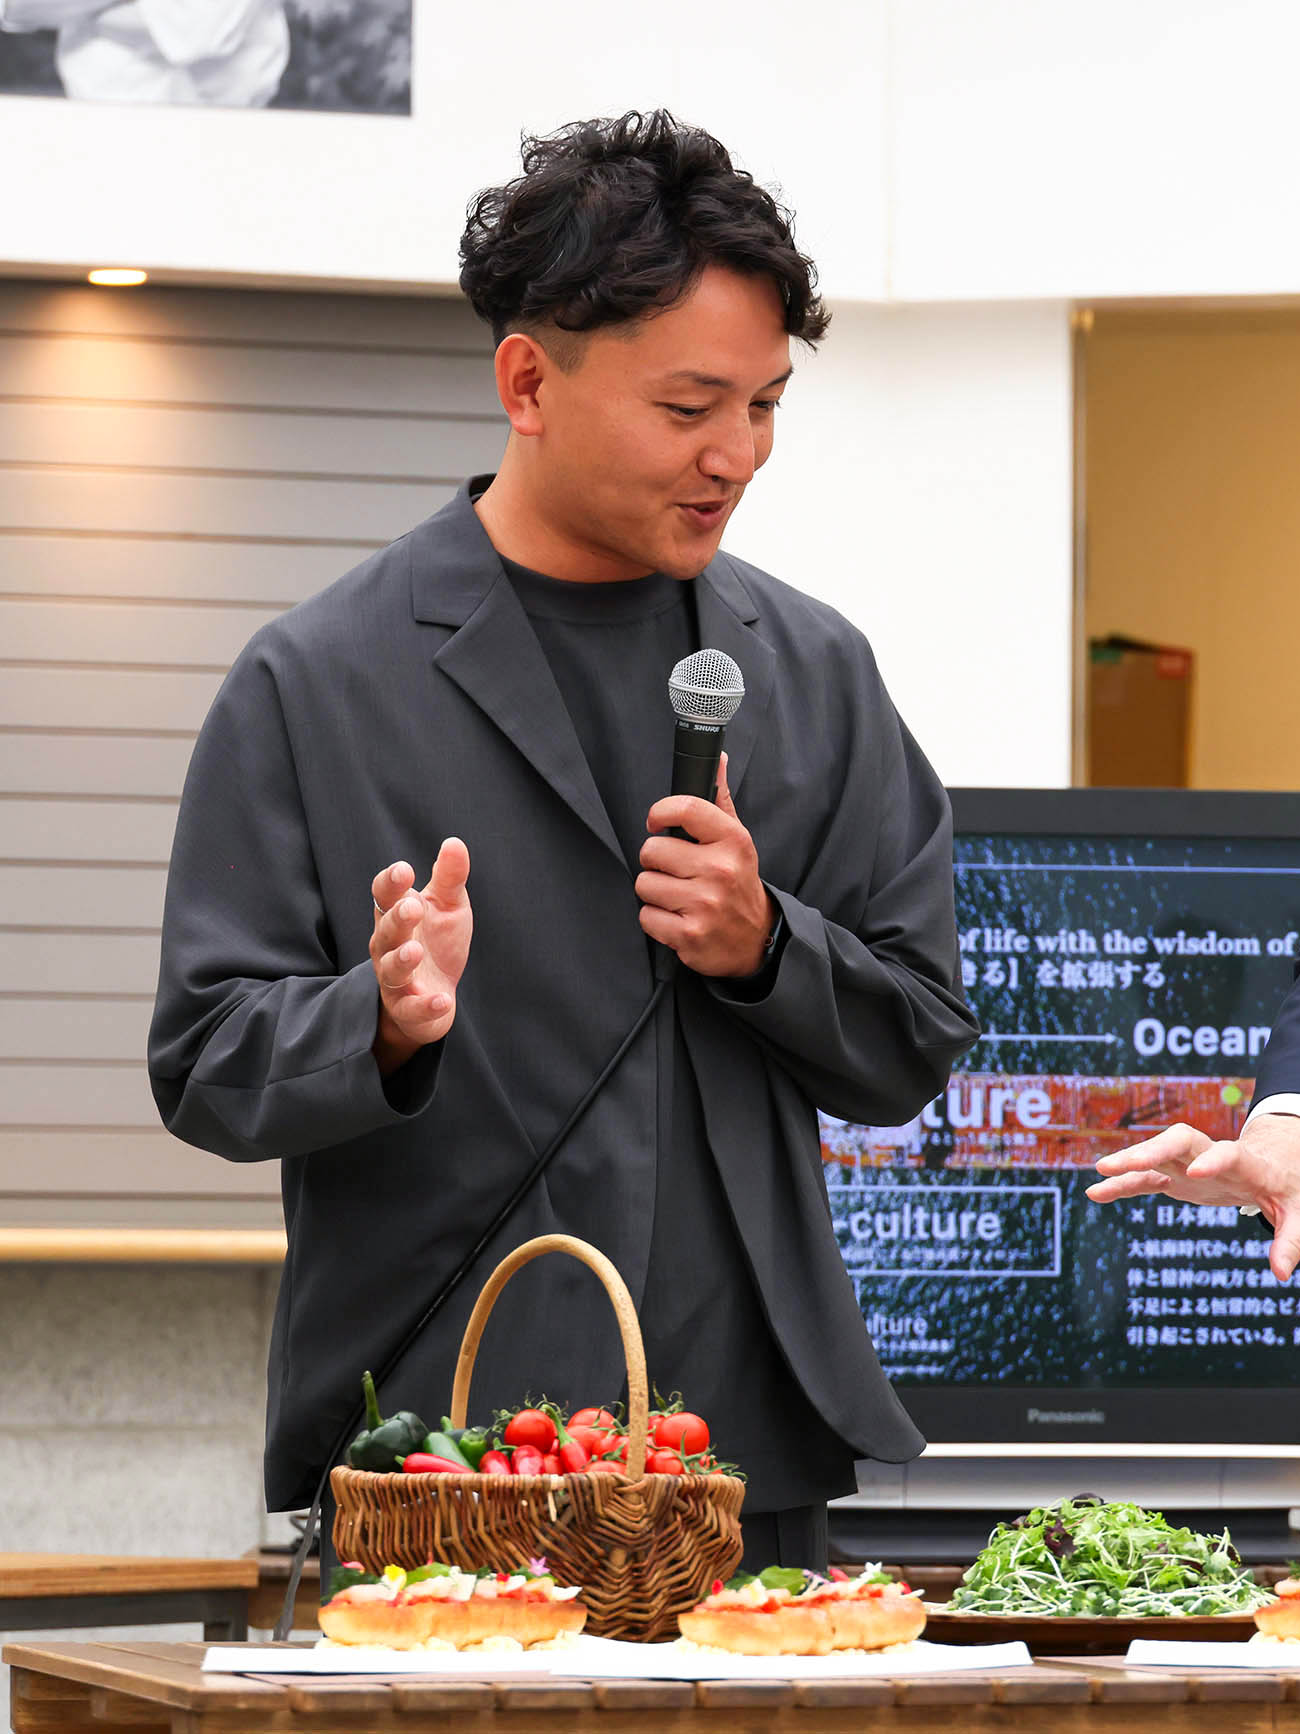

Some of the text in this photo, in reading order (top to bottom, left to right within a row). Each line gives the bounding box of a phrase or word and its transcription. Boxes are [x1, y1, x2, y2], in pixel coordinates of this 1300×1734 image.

[985, 928, 1030, 952] life
[1035, 929, 1097, 954] with
[1103, 929, 1148, 955] the
[1152, 930, 1261, 956] wisdom
[1267, 931, 1299, 956] of
